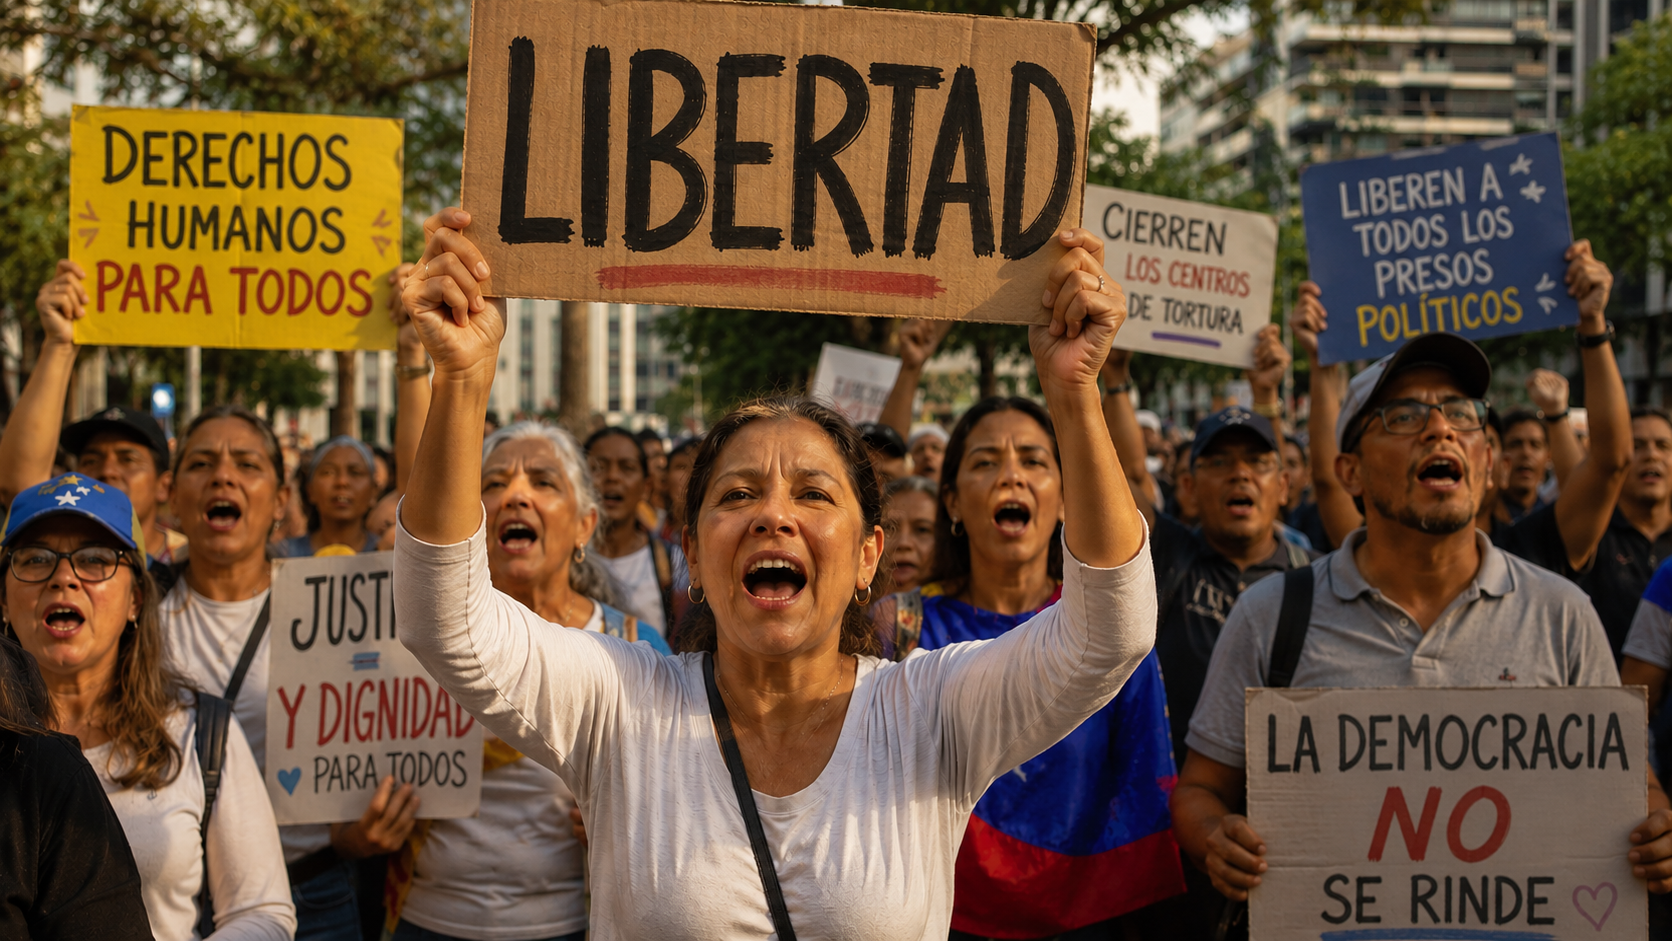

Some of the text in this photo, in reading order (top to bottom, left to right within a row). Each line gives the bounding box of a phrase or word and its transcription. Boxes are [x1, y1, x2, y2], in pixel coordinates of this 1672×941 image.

[102, 125, 352, 191] DERECHOS
[498, 36, 1077, 261] LIBERTAD
[1339, 162, 1504, 219] LIBEREN A
[127, 200, 346, 254] HUMANOS
[1102, 202, 1227, 256] CIERREN
[1352, 205, 1514, 257] TODOS LOS
[96, 260, 374, 317] PARA TODOS
[1125, 253, 1251, 298] LOS CENTROS
[1374, 248, 1493, 299] PRESOS
[1129, 292, 1243, 335] DE TORTURA
[1356, 286, 1523, 347] POLÍTICOS
[291, 570, 396, 651] JUSTI
[277, 684, 306, 749] Y
[1267, 712, 1630, 773] LA DEMOCRACIA
[314, 750, 468, 793] PARA TODOS
[1367, 785, 1512, 863] NO
[1320, 873, 1555, 925] SE RINDE
